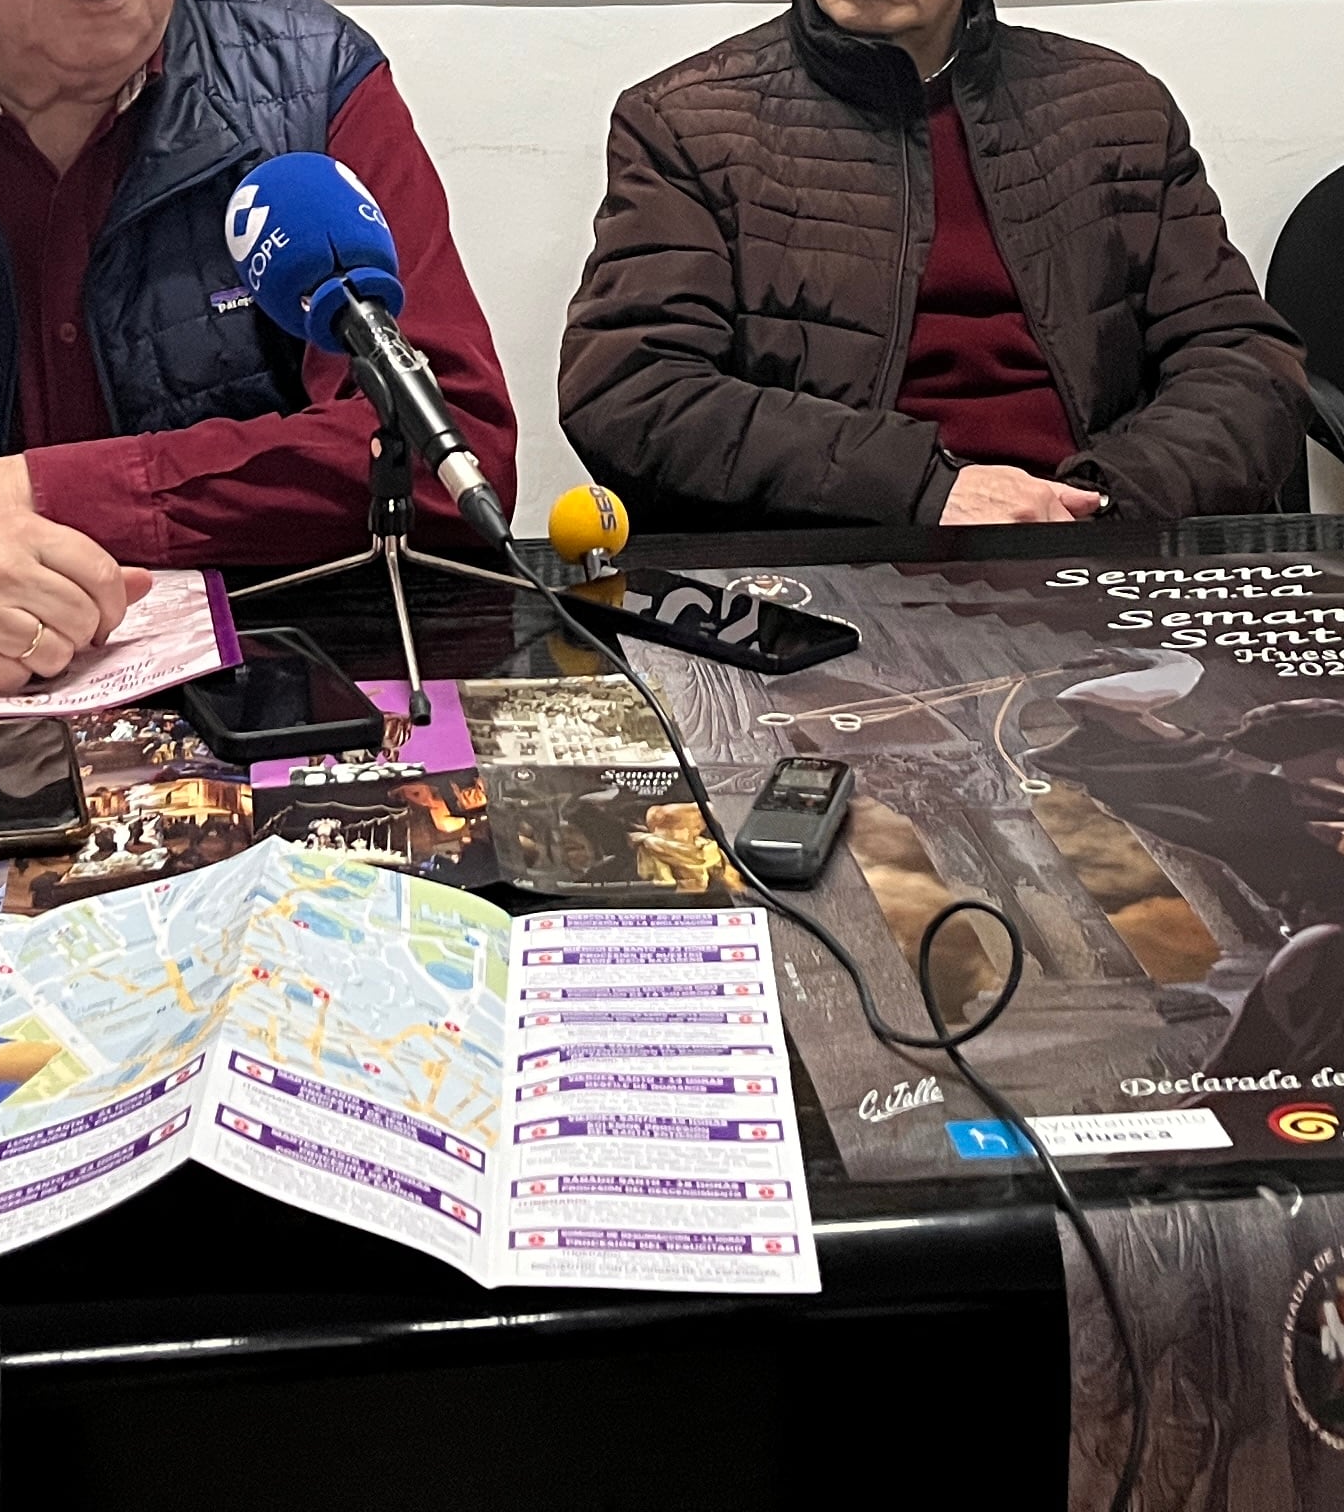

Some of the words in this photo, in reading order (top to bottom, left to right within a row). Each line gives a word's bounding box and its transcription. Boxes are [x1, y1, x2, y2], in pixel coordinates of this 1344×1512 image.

[358, 203, 389, 230] CO
[248, 227, 290, 291] COPE
[1046, 564, 1323, 587] Semana
[1120, 1068, 1302, 1097] Declarada
[1074, 1128, 1174, 1144] Huesca
